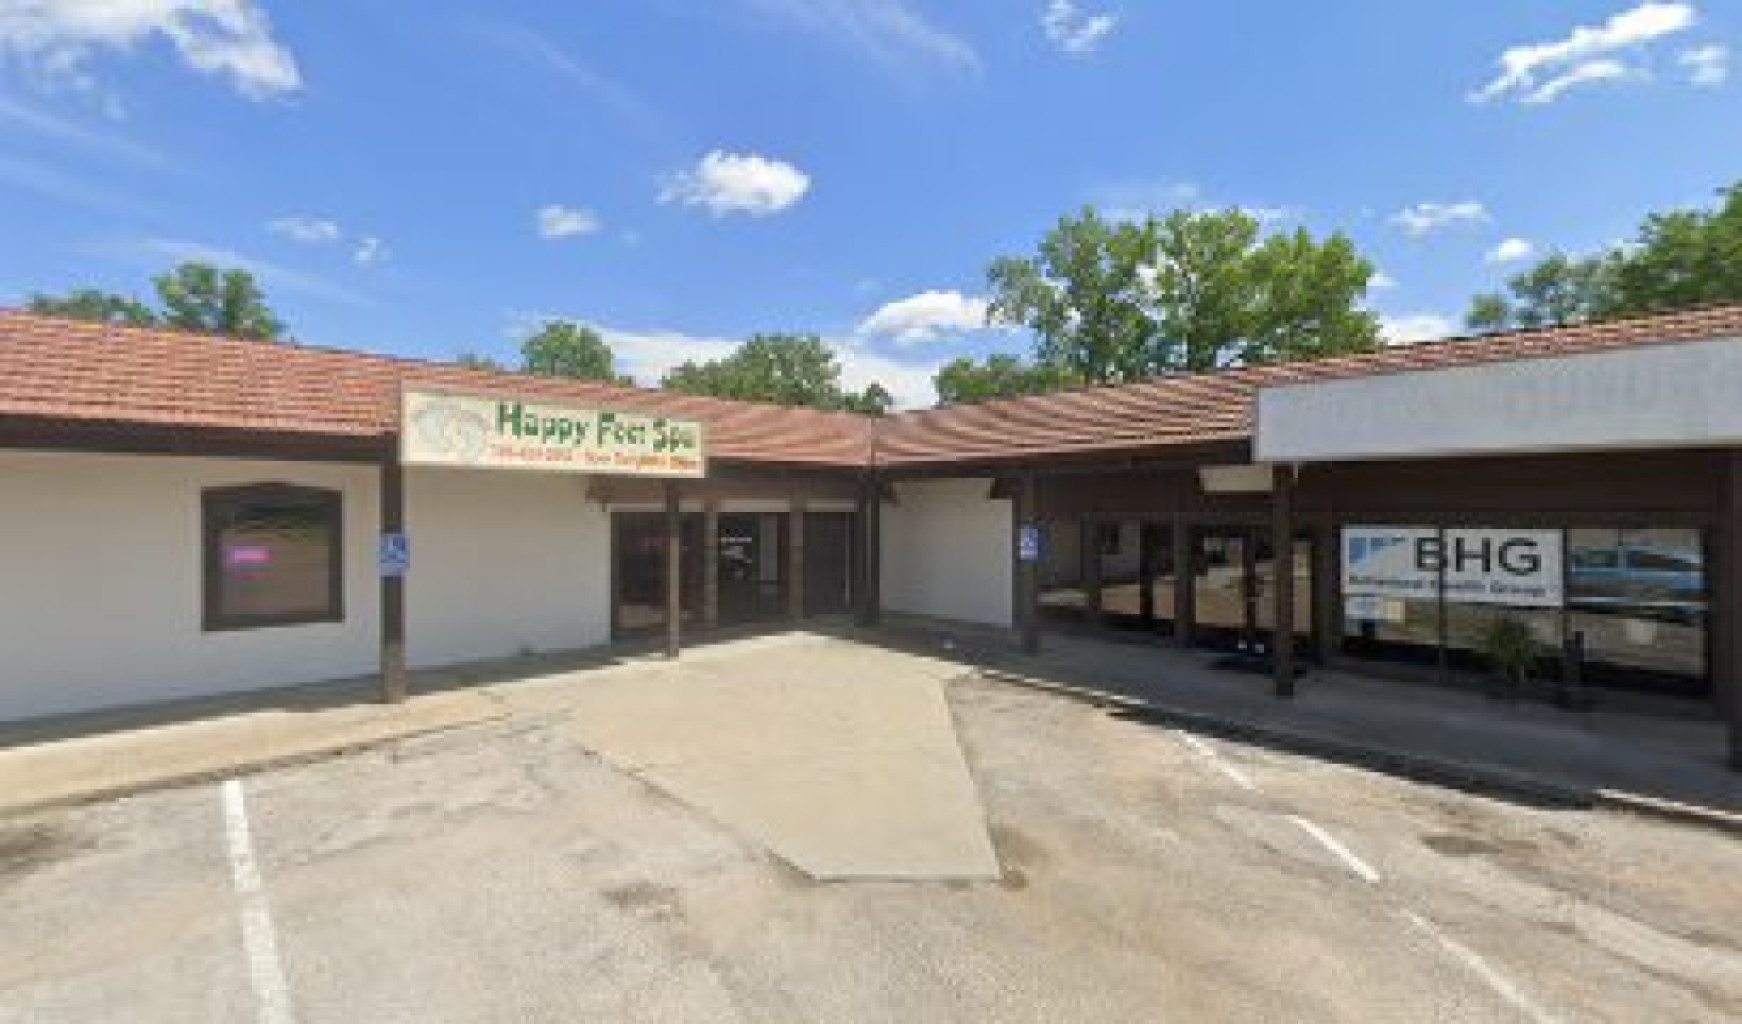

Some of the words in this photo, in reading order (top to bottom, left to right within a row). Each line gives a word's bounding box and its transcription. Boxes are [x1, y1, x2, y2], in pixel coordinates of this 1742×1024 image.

[496, 401, 590, 445] Happy
[598, 412, 646, 447] Feet
[652, 418, 695, 453] Spa
[1415, 537, 1542, 576] BHG
